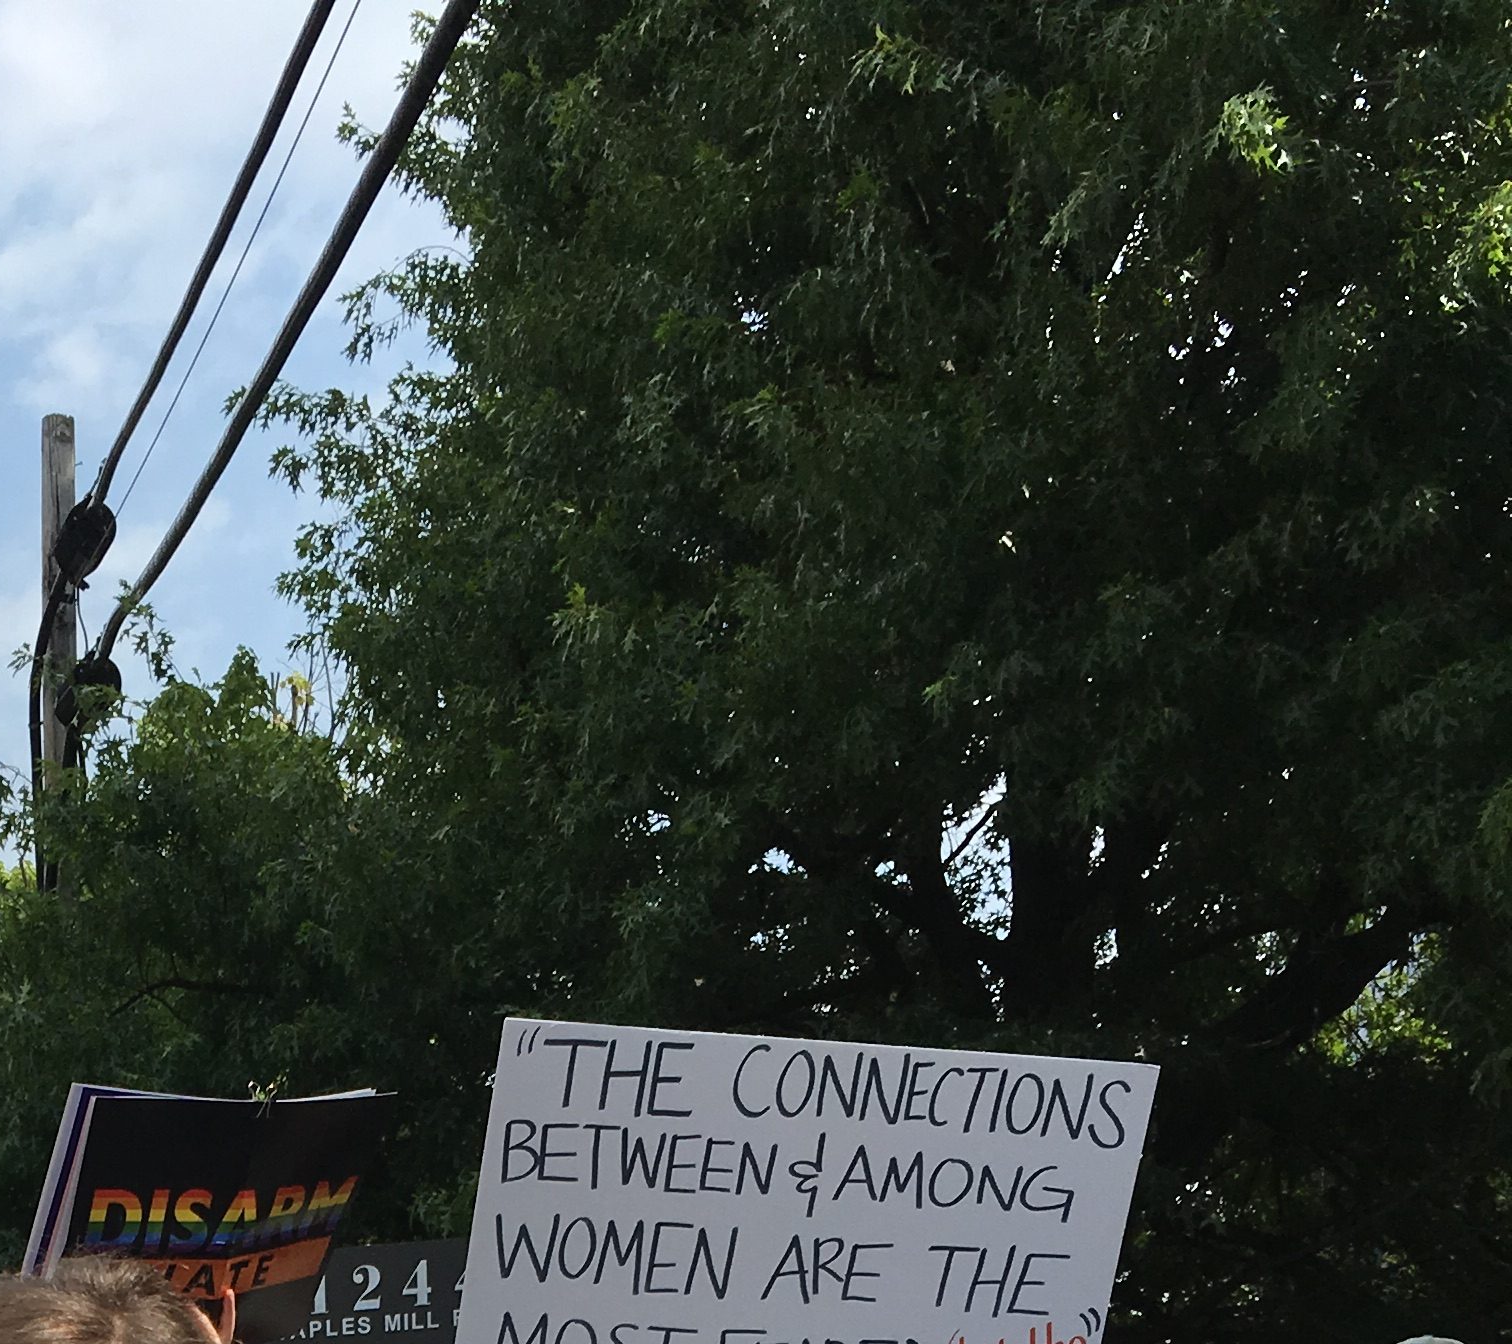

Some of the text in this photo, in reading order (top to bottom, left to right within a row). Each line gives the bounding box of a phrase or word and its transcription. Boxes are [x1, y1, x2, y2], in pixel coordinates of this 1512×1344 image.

[733, 1044, 1132, 1149] CONNECTIONS
[85, 1176, 359, 1253] DISARM
[500, 1119, 1075, 1223] BETWEEN & AMONG
[164, 1253, 274, 1297] ATE
[495, 1213, 1070, 1318] WOMEN ARE THE
[384, 1311, 440, 1333] MILL
